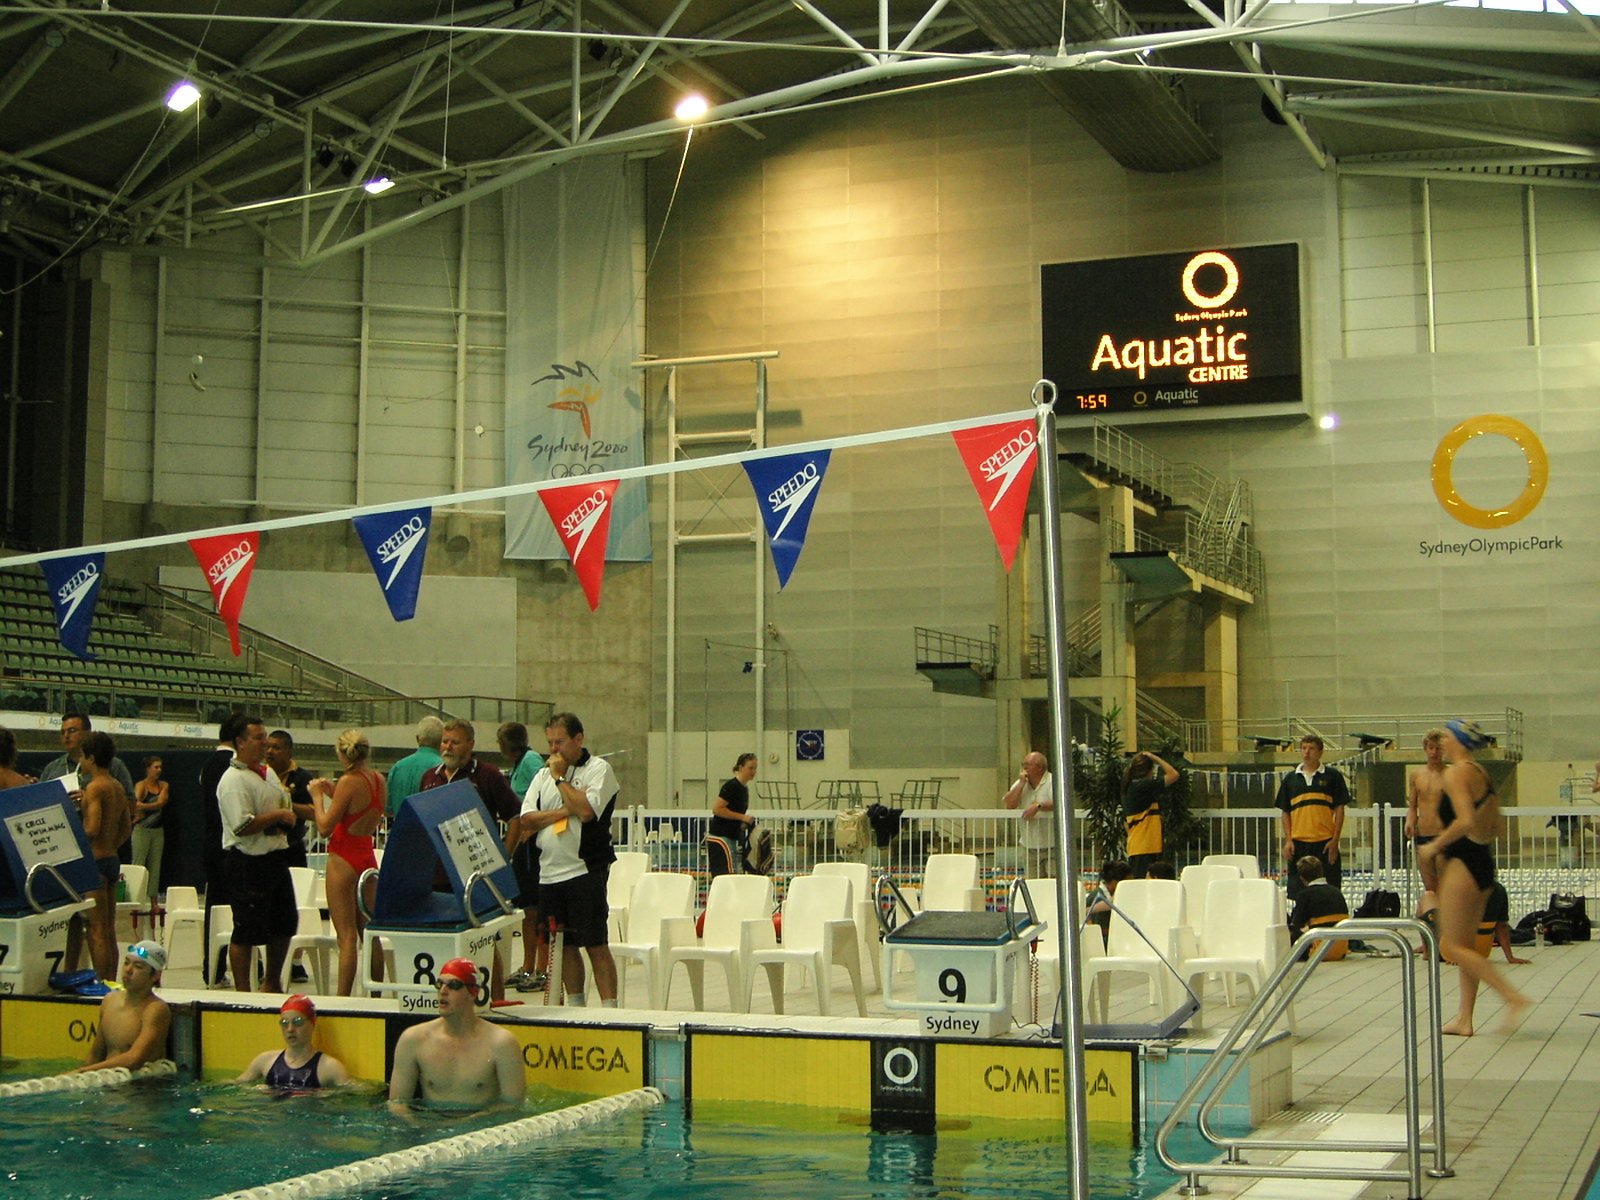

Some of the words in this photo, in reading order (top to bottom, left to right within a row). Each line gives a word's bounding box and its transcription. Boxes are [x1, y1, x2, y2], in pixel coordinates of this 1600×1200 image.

[1091, 325, 1247, 380] Aquatic
[1188, 364, 1248, 383] CENTRE
[1076, 394, 1107, 409] 7:59
[1155, 387, 1199, 404] Aquatic
[528, 434, 589, 461] Sydney
[591, 440, 628, 458] 2000
[979, 429, 1034, 480] SPEEDO
[768, 463, 817, 510] SPEEDO
[561, 489, 605, 535] SPEEDO
[376, 516, 423, 561] SPEEDO
[1419, 536, 1563, 558] SydneyOlympicPark
[209, 540, 251, 580] SPEEDO
[58, 562, 97, 599] SPEEDO
[38, 919, 70, 939] Sydney
[469, 934, 497, 956] Sydney
[45, 951, 65, 978] 7
[413, 952, 436, 985] 8
[938, 967, 966, 1004] 9
[402, 994, 440, 1013] Sydne
[926, 1015, 980, 1034] Sydney
[522, 1043, 631, 1073] OMEGA
[984, 1064, 1118, 1097] OMEA
